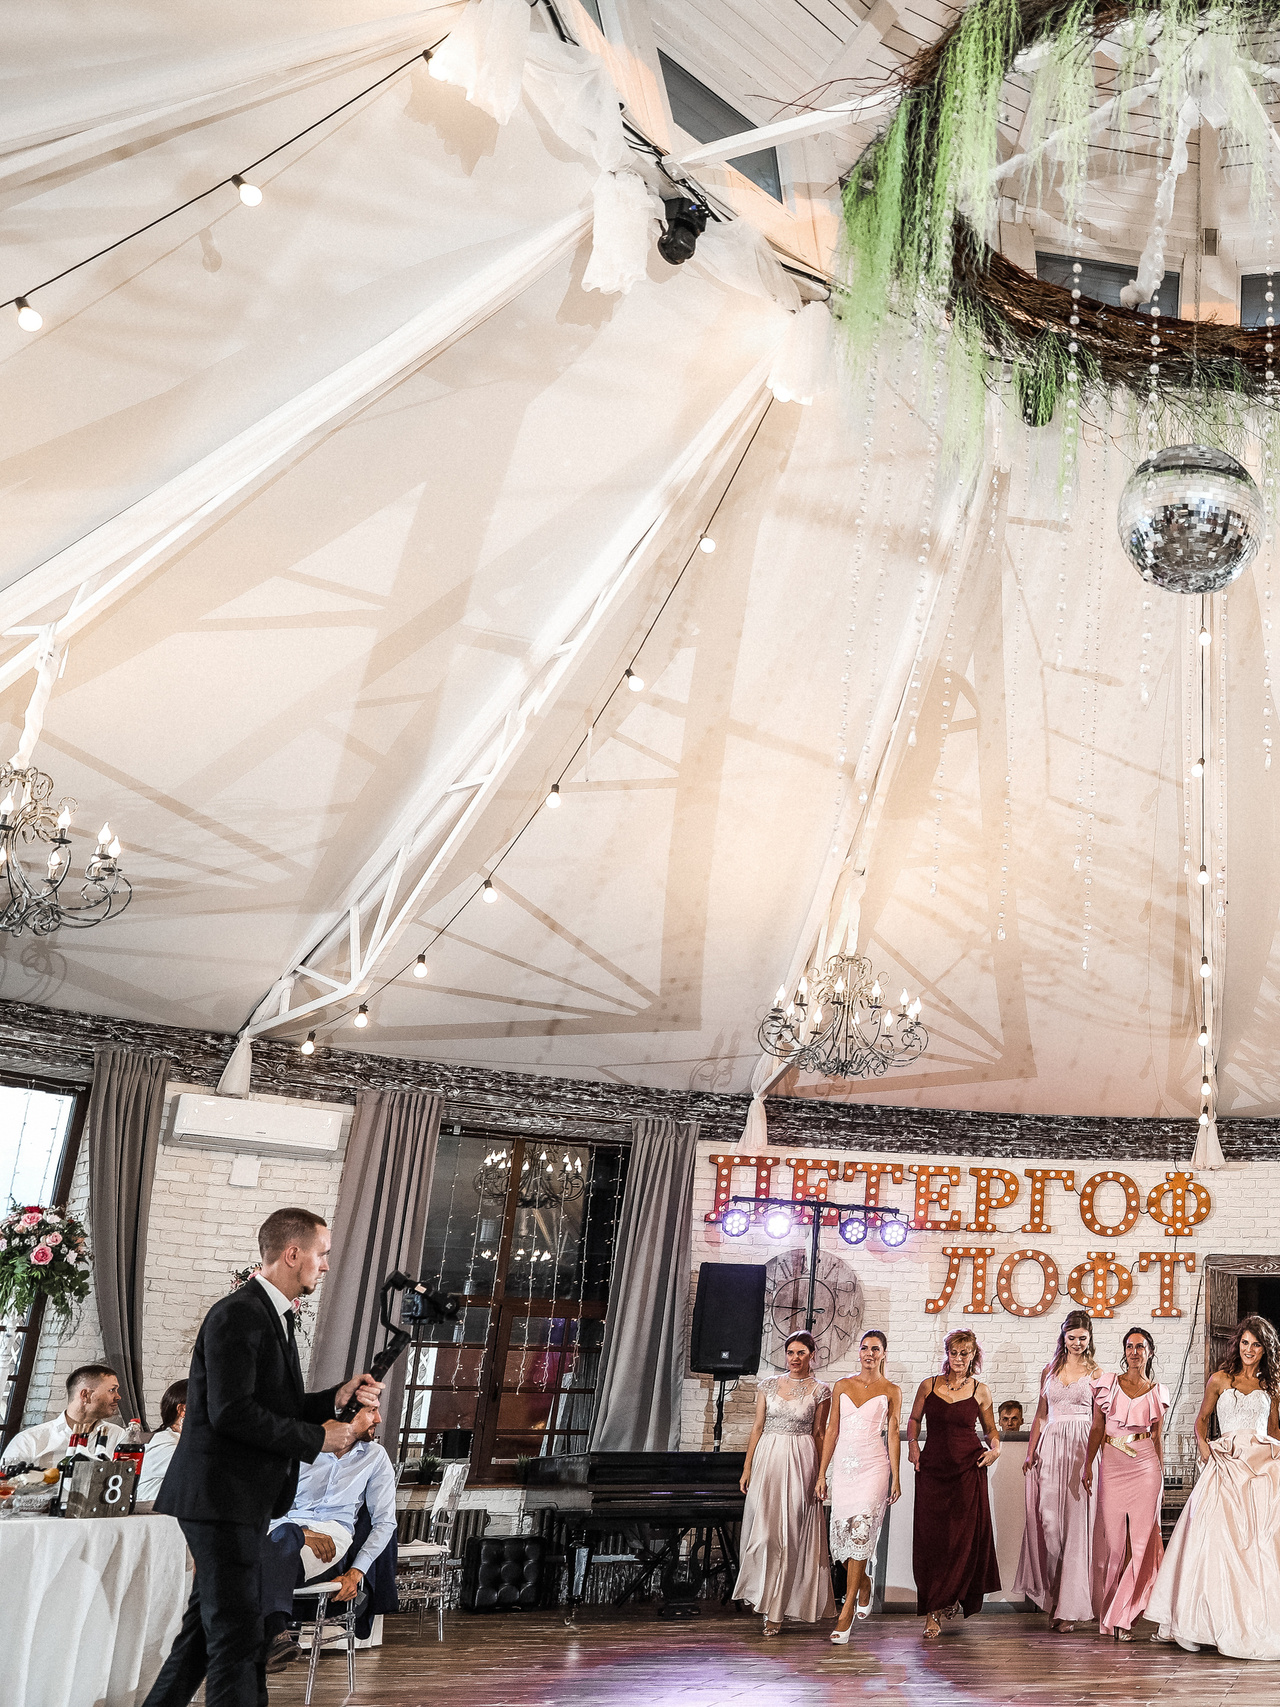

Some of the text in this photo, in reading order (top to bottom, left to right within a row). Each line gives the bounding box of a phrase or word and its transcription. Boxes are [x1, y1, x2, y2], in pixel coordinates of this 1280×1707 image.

[704, 1154, 1211, 1237] ПЕТЕРГОФ
[924, 1246, 1196, 1319] ЛОФТ
[105, 1474, 123, 1504] 8
